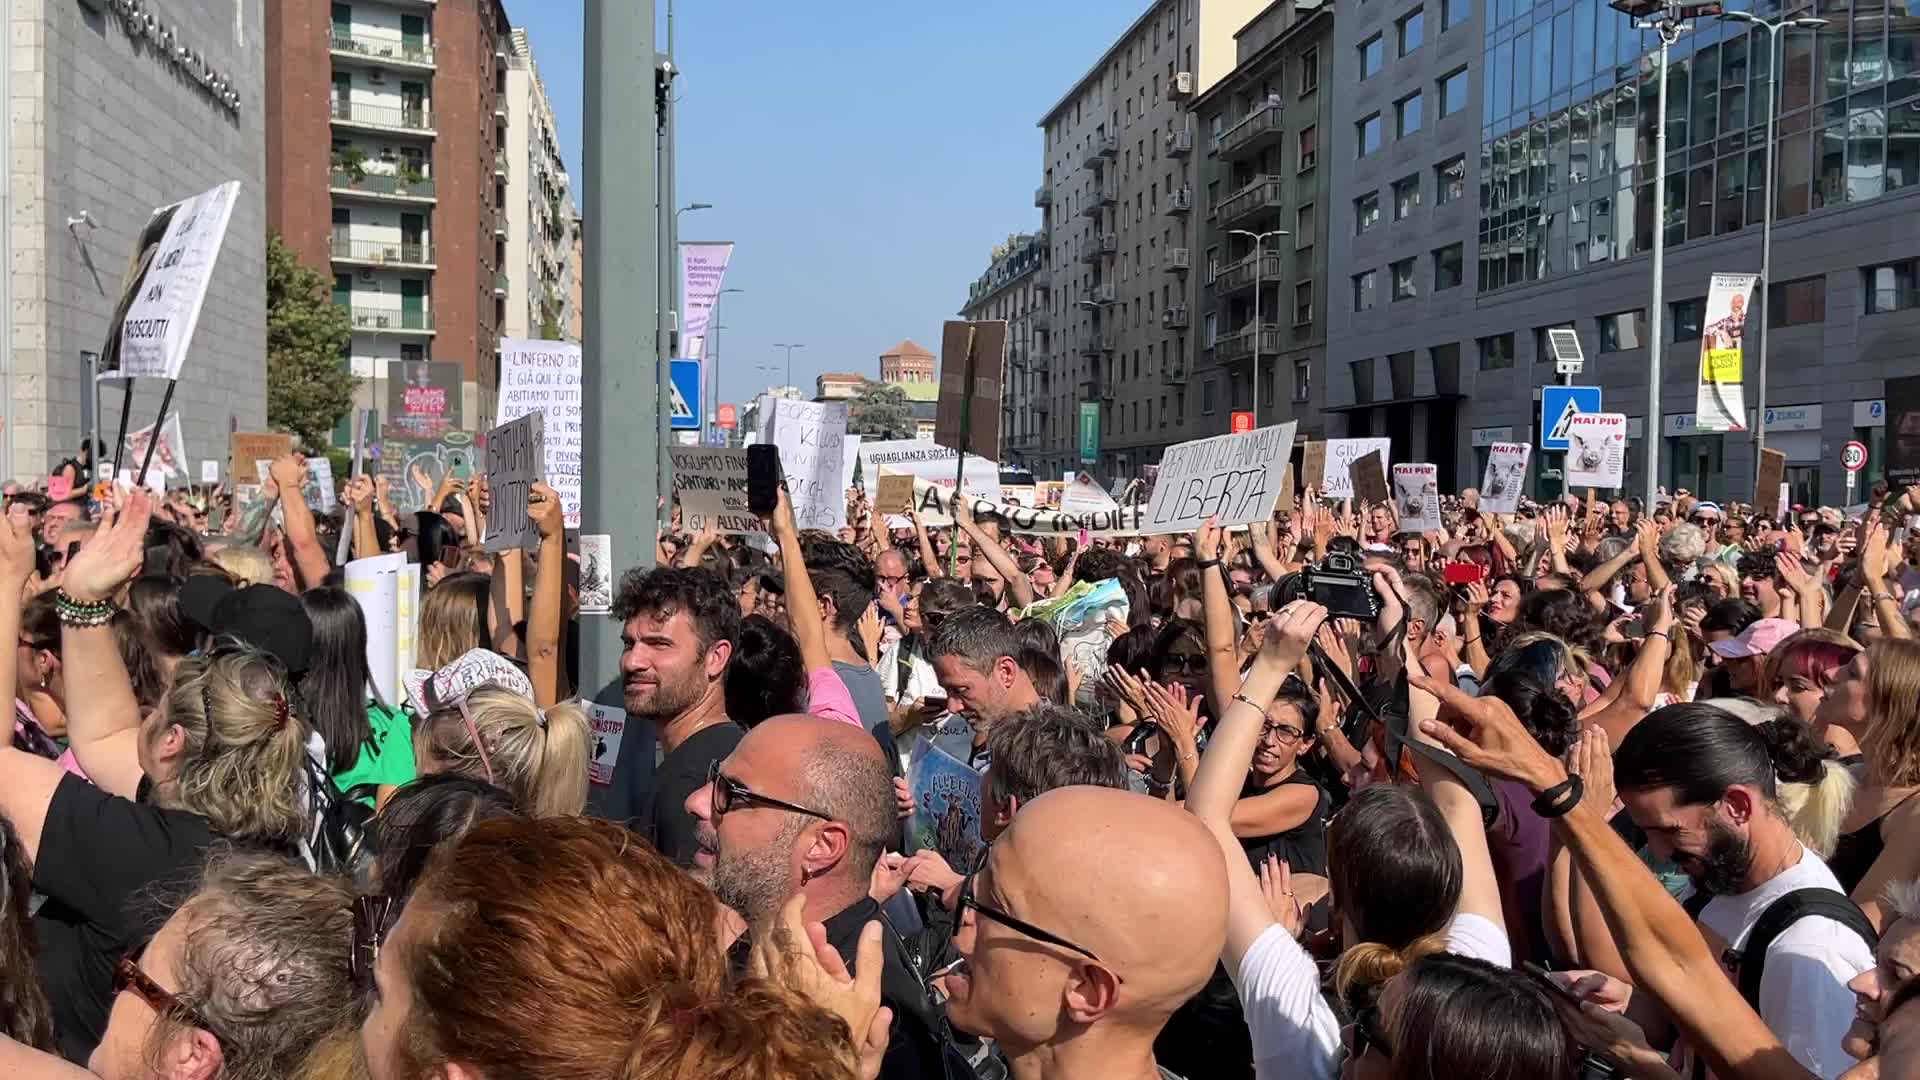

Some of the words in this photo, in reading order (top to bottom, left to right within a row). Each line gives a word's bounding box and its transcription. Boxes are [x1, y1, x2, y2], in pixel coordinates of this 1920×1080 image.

[507, 390, 550, 402] ABITIAMO
[1573, 417, 1596, 425] MAI
[869, 450, 926, 463] UGUAGLIANZA
[1394, 466, 1413, 475] MAI
[1153, 464, 1267, 524] LIBERTÀ
